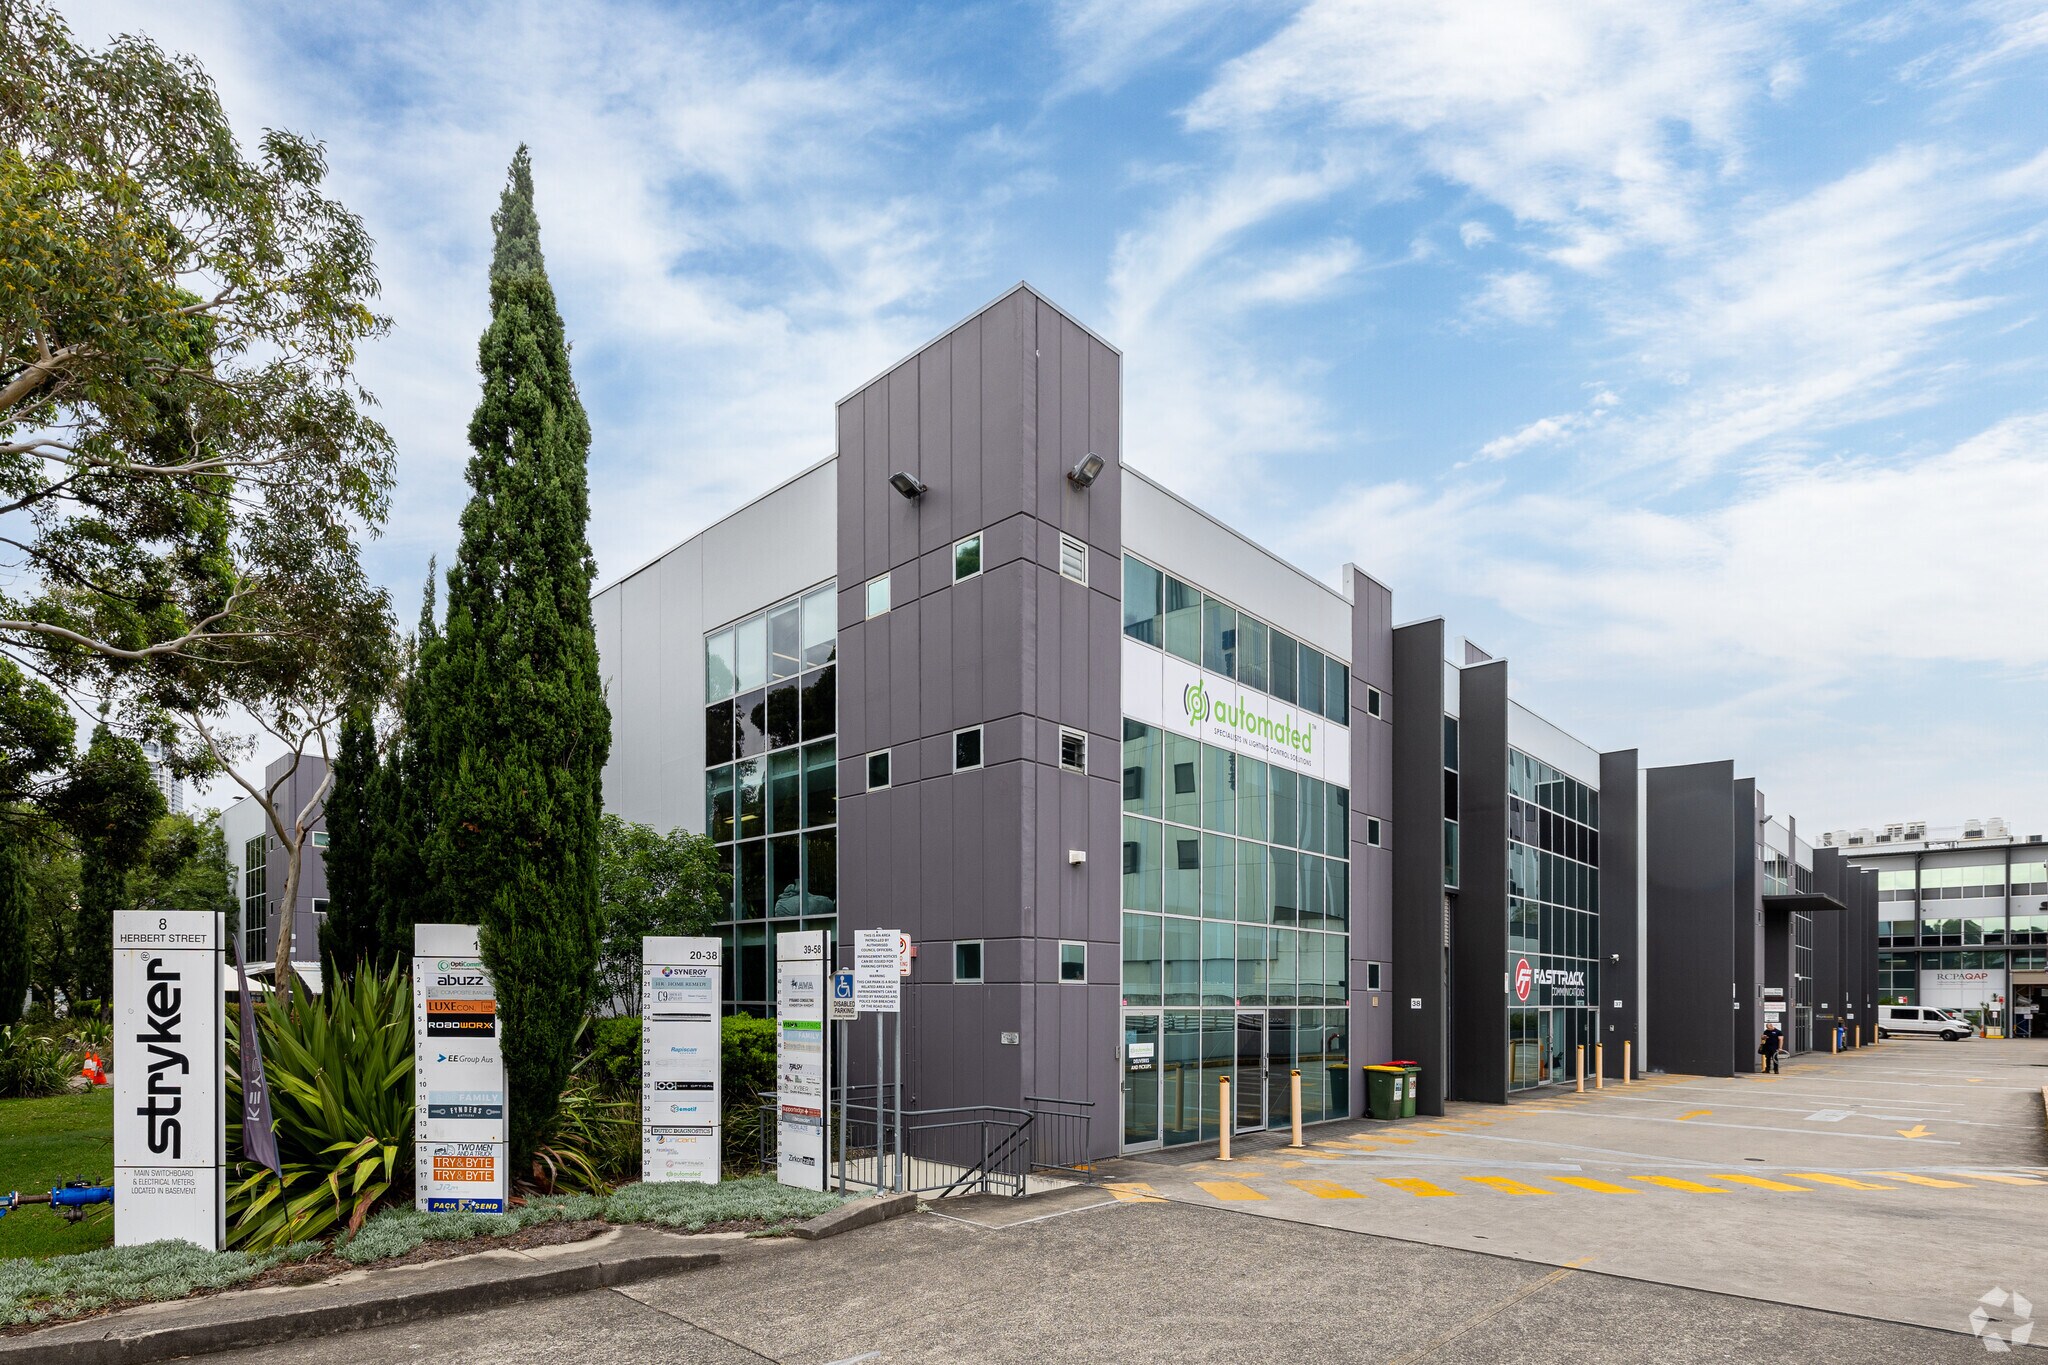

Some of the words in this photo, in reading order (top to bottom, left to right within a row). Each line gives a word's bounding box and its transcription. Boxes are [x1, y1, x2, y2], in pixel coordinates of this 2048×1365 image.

[1214, 696, 1312, 754] automated
[1214, 728, 1242, 743] SPECIALISTS
[1249, 740, 1269, 752] LIGHTING
[1270, 746, 1290, 760] CONTROL
[1290, 753, 1312, 766] SOLUTIONS
[159, 918, 167, 930] 8
[120, 934, 166, 942] HERBERT
[168, 934, 207, 942] STREET
[804, 945, 821, 954] 39-58
[690, 951, 718, 960] 20-38
[438, 974, 484, 985] abuzz
[1534, 968, 1584, 986] FASTTRACK
[1552, 986, 1584, 996] COMMUNICATIONS
[136, 958, 190, 1160] stryker
[460, 1056, 479, 1064] Group
[435, 1158, 456, 1167] TRY
[456, 1158, 464, 1167] &
[466, 1158, 492, 1168] BYTE
[435, 1170, 456, 1180] TRY
[456, 1171, 464, 1180] &
[466, 1170, 492, 1180] BYTE
